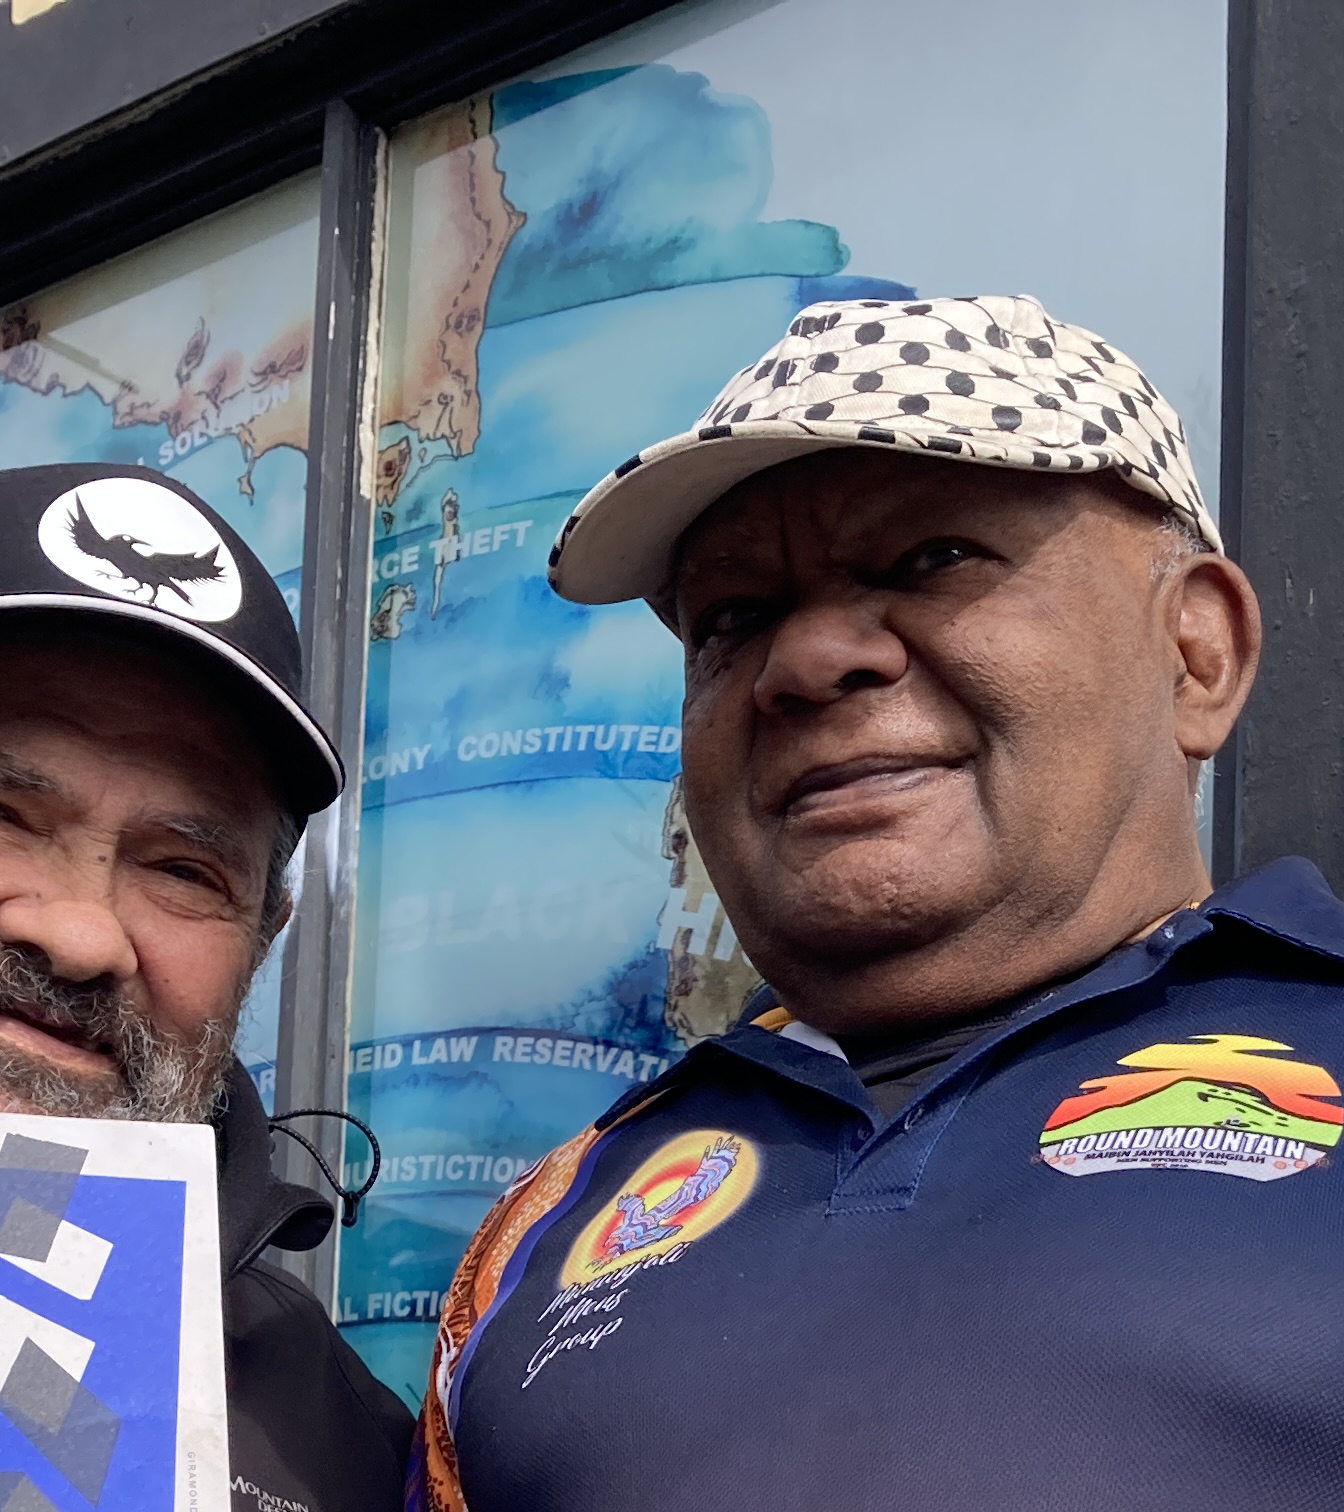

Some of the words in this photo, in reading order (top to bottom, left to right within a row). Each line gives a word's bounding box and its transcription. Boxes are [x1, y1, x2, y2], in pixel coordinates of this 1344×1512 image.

[429, 520, 533, 565] THEFT
[362, 743, 432, 784] ONY
[457, 725, 682, 762] CONSTITUTED
[412, 1036, 478, 1067] LAW
[1058, 1128, 1154, 1156] ROUND
[1158, 1127, 1306, 1159] MOUNTAIN
[521, 1317, 623, 1389] Group
